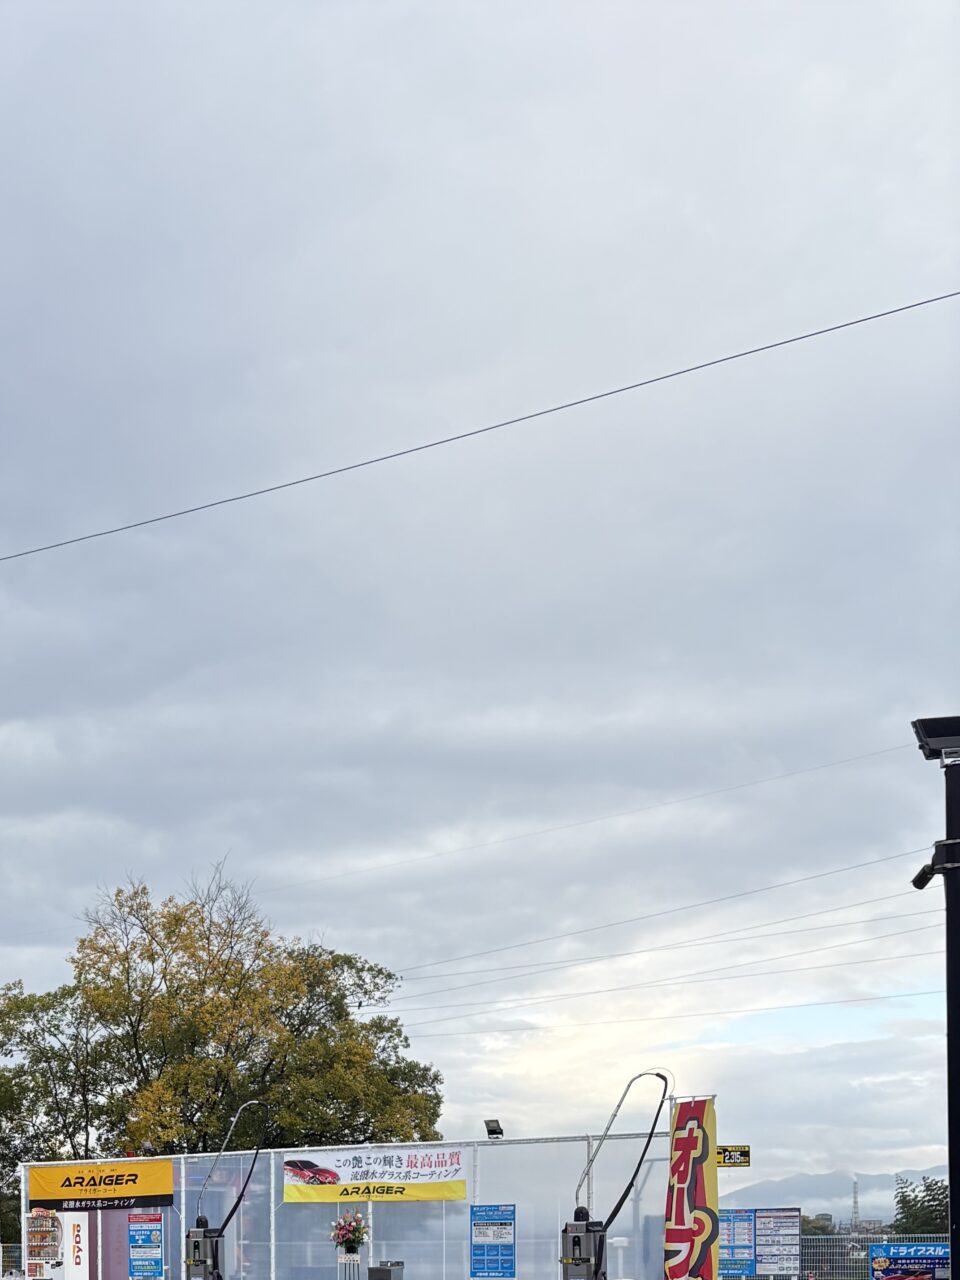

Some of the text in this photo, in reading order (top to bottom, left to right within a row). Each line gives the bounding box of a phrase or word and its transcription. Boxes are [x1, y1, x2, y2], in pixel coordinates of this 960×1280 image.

[406, 1151, 462, 1169] 最高品質
[60, 1173, 139, 1188] ARAIGER
[339, 1185, 406, 1197] ARAIGER
[73, 1223, 83, 1266] DyDo
